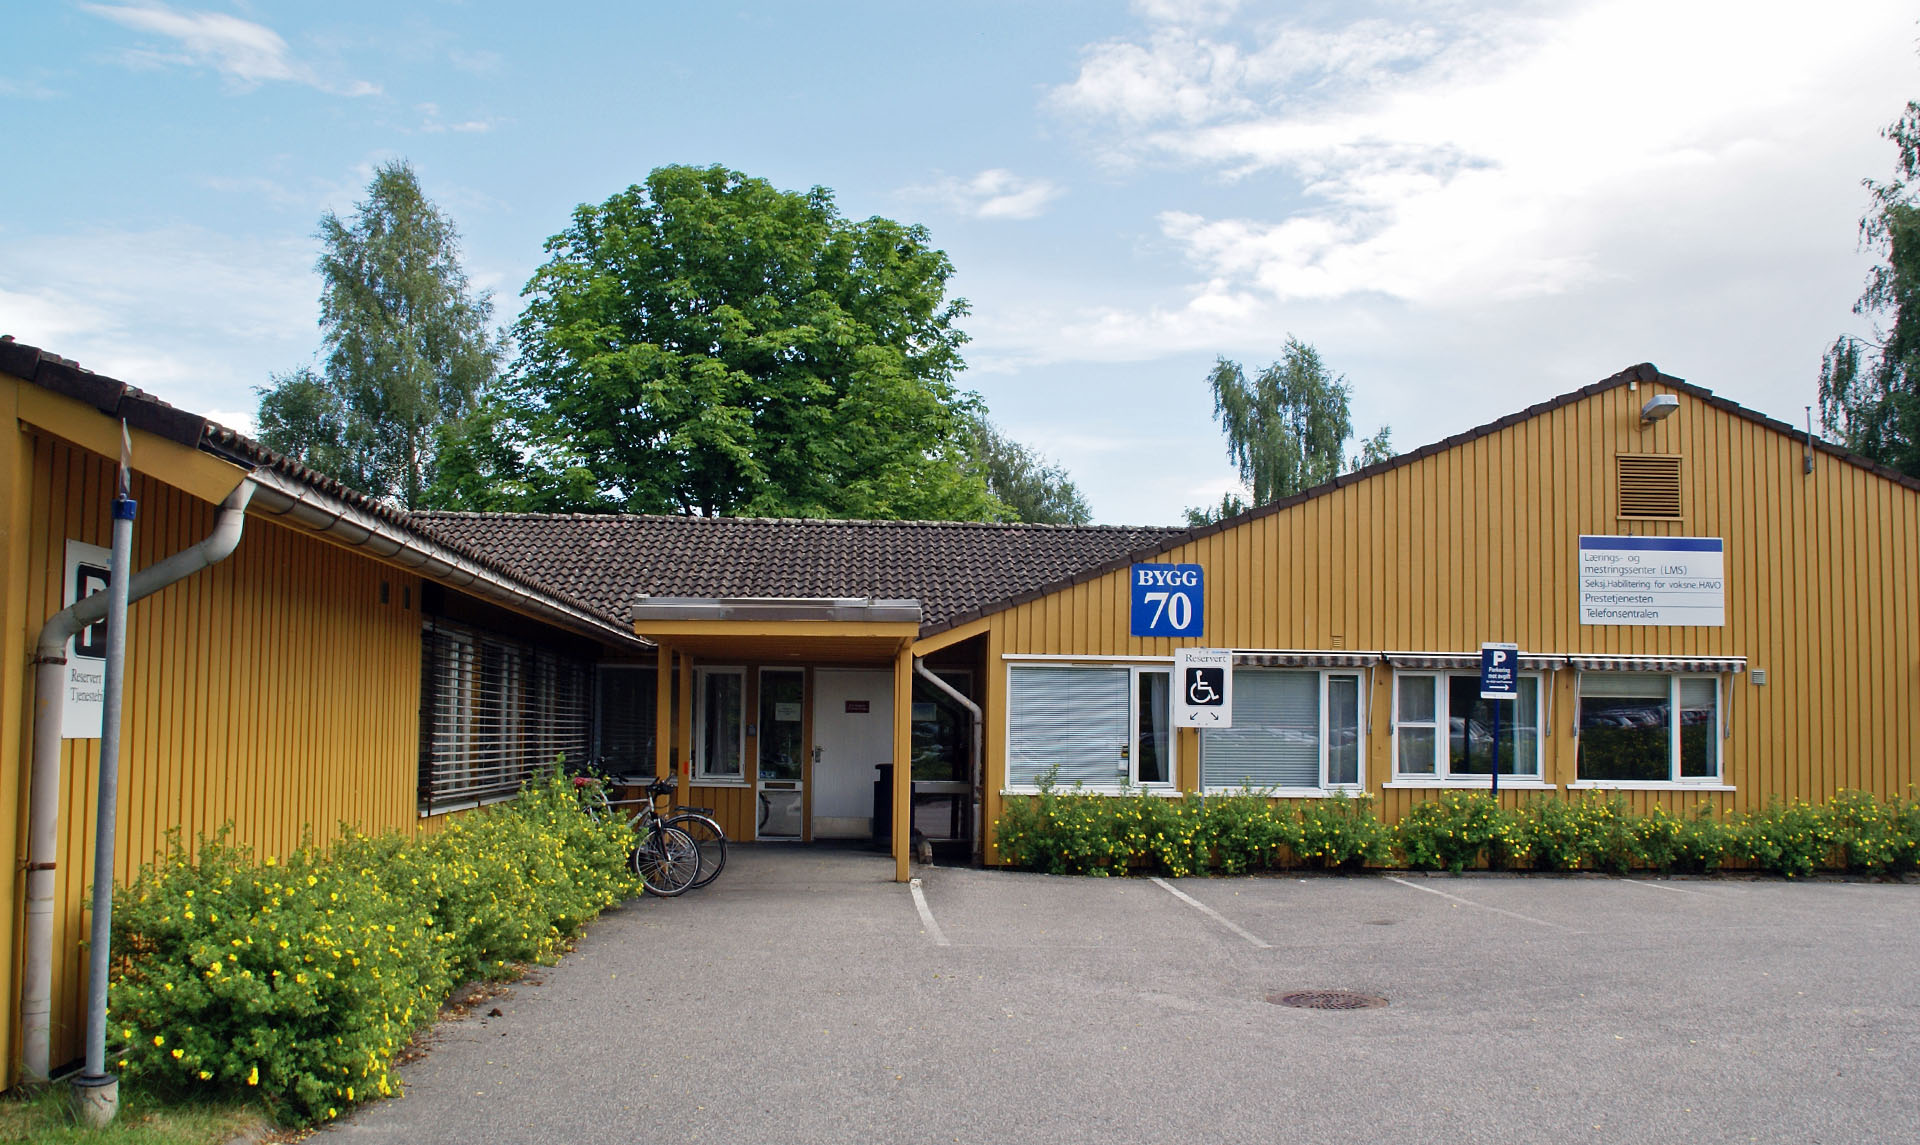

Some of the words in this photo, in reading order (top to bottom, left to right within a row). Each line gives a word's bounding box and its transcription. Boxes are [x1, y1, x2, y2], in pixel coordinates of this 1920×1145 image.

[1584, 553, 1623, 563] Lærings-
[1627, 554, 1640, 564] og
[1585, 565, 1656, 576] mestringssenter
[1660, 565, 1687, 576] (LMS)
[1138, 570, 1198, 587] BYGG
[1654, 580, 1665, 589] for
[1585, 593, 1654, 604] Prestetjenesten
[1144, 592, 1192, 630] 70
[1586, 608, 1659, 619] Telefonsentralen
[1185, 653, 1226, 663] Reservert
[1493, 651, 1506, 666] P
[71, 668, 102, 684] Reservert
